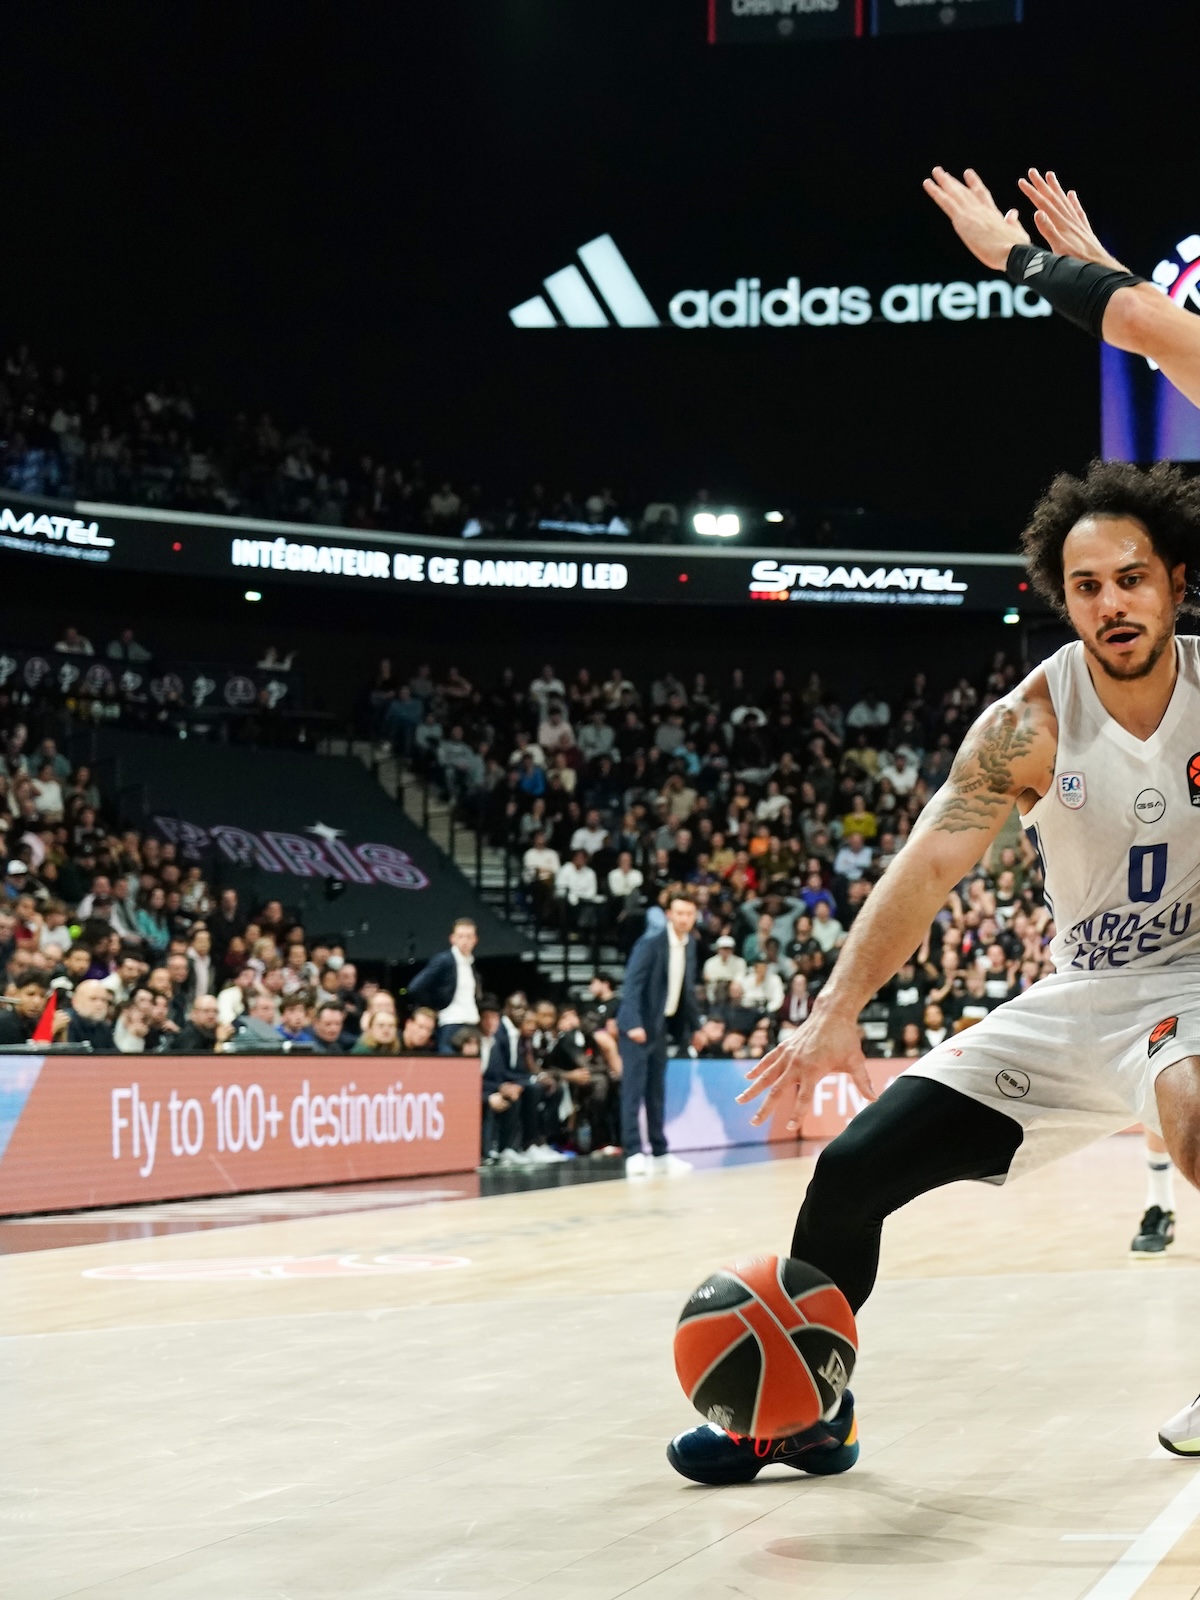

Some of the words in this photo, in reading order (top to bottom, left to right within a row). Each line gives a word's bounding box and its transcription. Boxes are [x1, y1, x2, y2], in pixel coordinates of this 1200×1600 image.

[669, 277, 872, 328] adidas
[881, 279, 1053, 323] arena
[0, 507, 115, 547] MATEL
[231, 536, 390, 579] INTÉGRATEUR
[393, 553, 425, 583] DE
[428, 556, 459, 585] CE
[463, 558, 578, 589] BANDEAU
[581, 562, 628, 590] LED
[749, 560, 968, 593] STRAMATEL
[1136, 801, 1164, 810] GSA
[1128, 842, 1169, 903] 0
[111, 1083, 161, 1178] Fly
[168, 1089, 204, 1157] to
[211, 1083, 284, 1152] 100+
[290, 1080, 445, 1149] destinations
